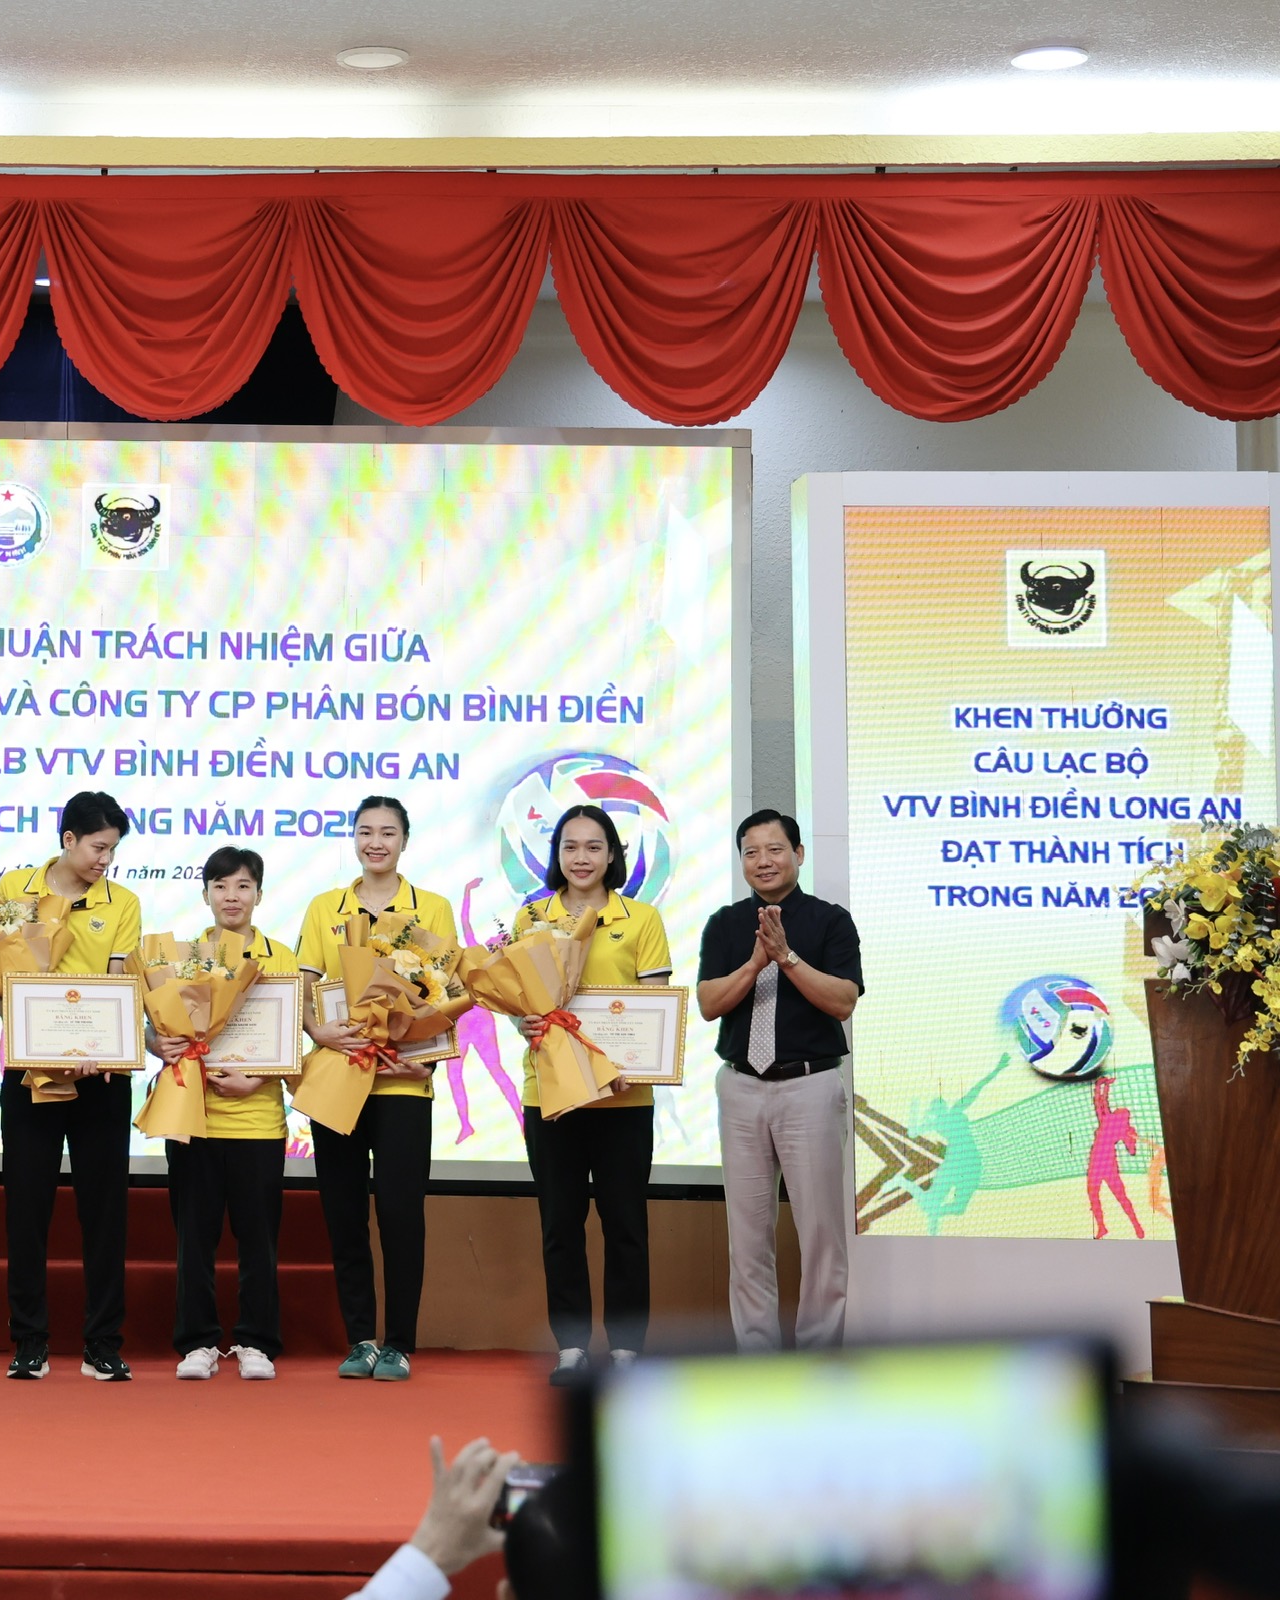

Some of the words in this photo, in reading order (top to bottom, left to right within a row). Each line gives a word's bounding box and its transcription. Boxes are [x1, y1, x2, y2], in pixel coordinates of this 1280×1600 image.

[91, 623, 208, 660] TRÁCH
[220, 625, 333, 668] NHIỆM
[344, 626, 431, 663] GIỮA
[49, 680, 148, 718] CÔNG
[157, 690, 201, 718] TY
[209, 690, 256, 719] CP
[266, 684, 364, 720] PHÂN
[376, 685, 451, 721] BÓN
[463, 686, 548, 722] BÌNH
[558, 682, 644, 724] ĐIỀN
[954, 707, 1032, 729] KHEN
[1040, 701, 1167, 730] THƯỞNG
[35, 748, 105, 775] VTV
[114, 739, 199, 777] BÌNH
[209, 736, 293, 778] ĐIỀN
[305, 751, 400, 780] LONG
[408, 752, 460, 780] AN
[974, 746, 1033, 773] CÂU
[1043, 752, 1096, 779] LẠC
[1106, 747, 1149, 779] BỘ
[48, 806, 172, 835] TNG
[183, 800, 264, 837] NĂM
[883, 795, 942, 818] VTV
[950, 790, 1021, 819] BÌNH
[1029, 787, 1100, 819] ĐIỀN
[1109, 796, 1190, 820] LONG
[1198, 797, 1242, 820] AN
[941, 840, 1001, 868] ĐẠT
[1009, 835, 1110, 864] THÀNH
[1118, 835, 1183, 865] TÍCH
[126, 865, 166, 879] năm
[171, 865, 205, 880] 202
[928, 885, 1032, 908] TRONG
[1041, 881, 1110, 908] NĂM
